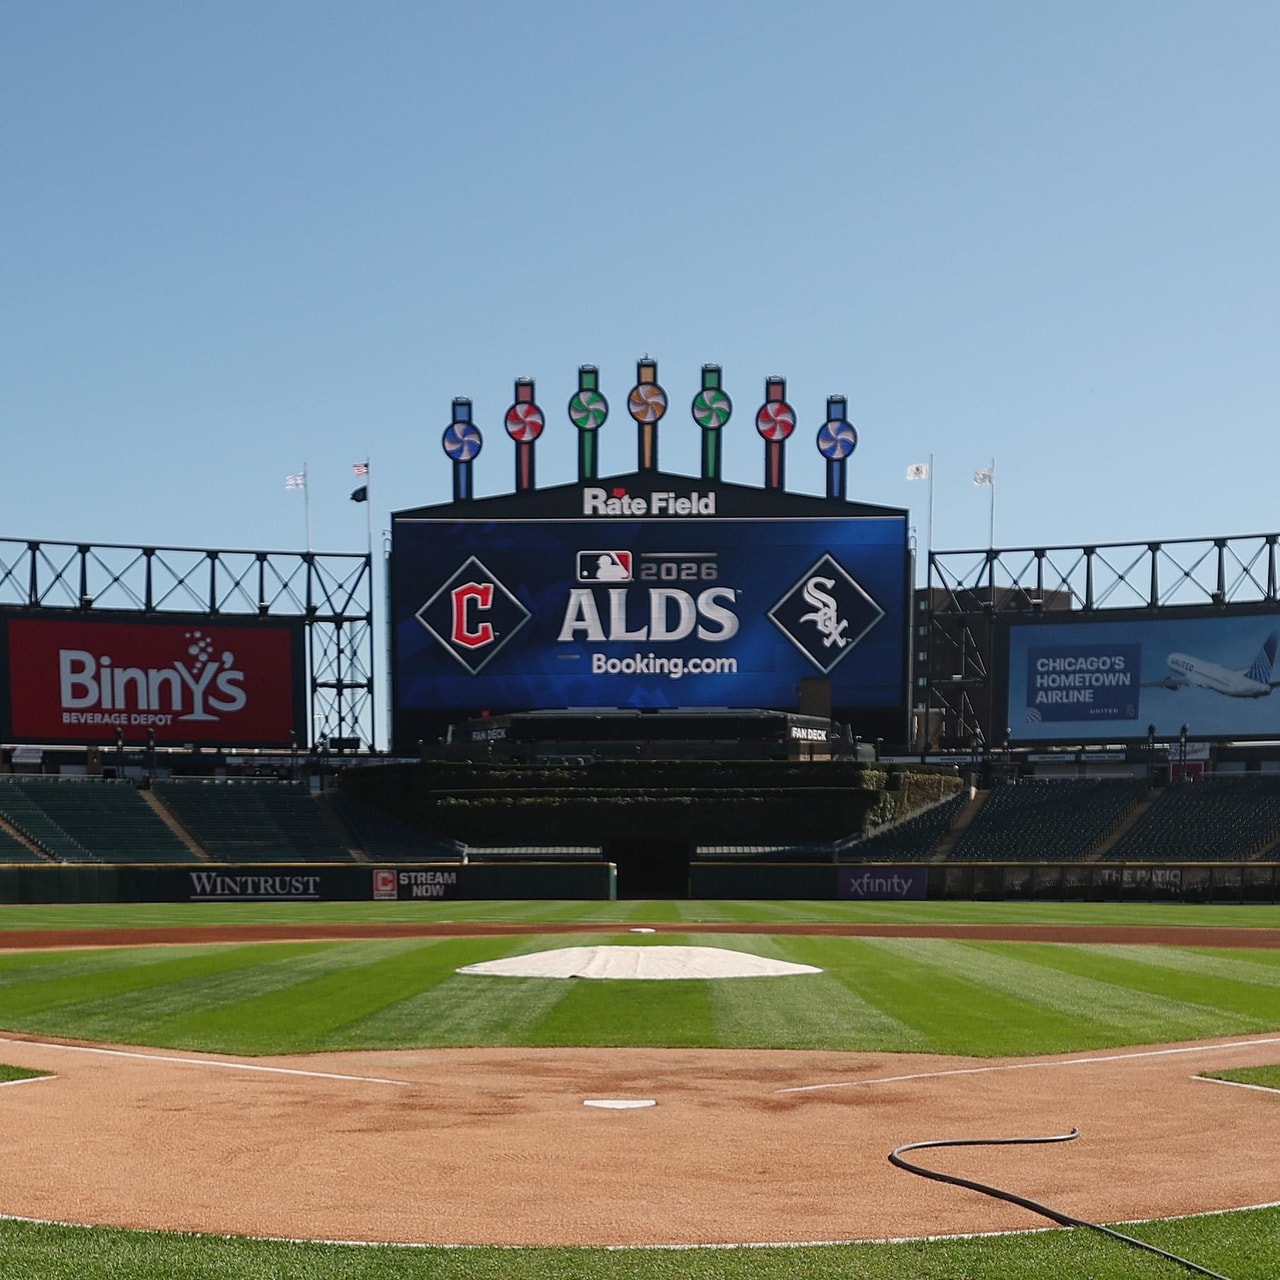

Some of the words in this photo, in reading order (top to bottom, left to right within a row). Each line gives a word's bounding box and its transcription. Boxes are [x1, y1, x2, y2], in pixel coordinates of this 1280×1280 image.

[583, 487, 647, 515] Rate
[651, 491, 716, 514] Field
[640, 562, 718, 581] 2026
[557, 587, 740, 642] ALDS
[591, 653, 738, 678] Booking.com
[1036, 656, 1126, 672] CHICAGO'S
[59, 648, 247, 720] Binny's
[1036, 672, 1132, 688] HOMETOWN
[1035, 689, 1095, 704] AIRLINE
[62, 712, 129, 725] BEVERAGE
[130, 713, 173, 726] DEPOT
[1090, 707, 1119, 715] UNITED
[472, 731, 487, 741] FAN
[488, 728, 506, 740] DECK
[792, 727, 807, 740] FAN
[807, 728, 827, 741] DECK
[189, 872, 320, 895] WINTRUST
[399, 871, 457, 885] STREAM
[1101, 869, 1133, 882] THE
[1136, 869, 1180, 882] PATIO
[412, 884, 445, 897] NOW
[850, 872, 913, 896] xfinity
